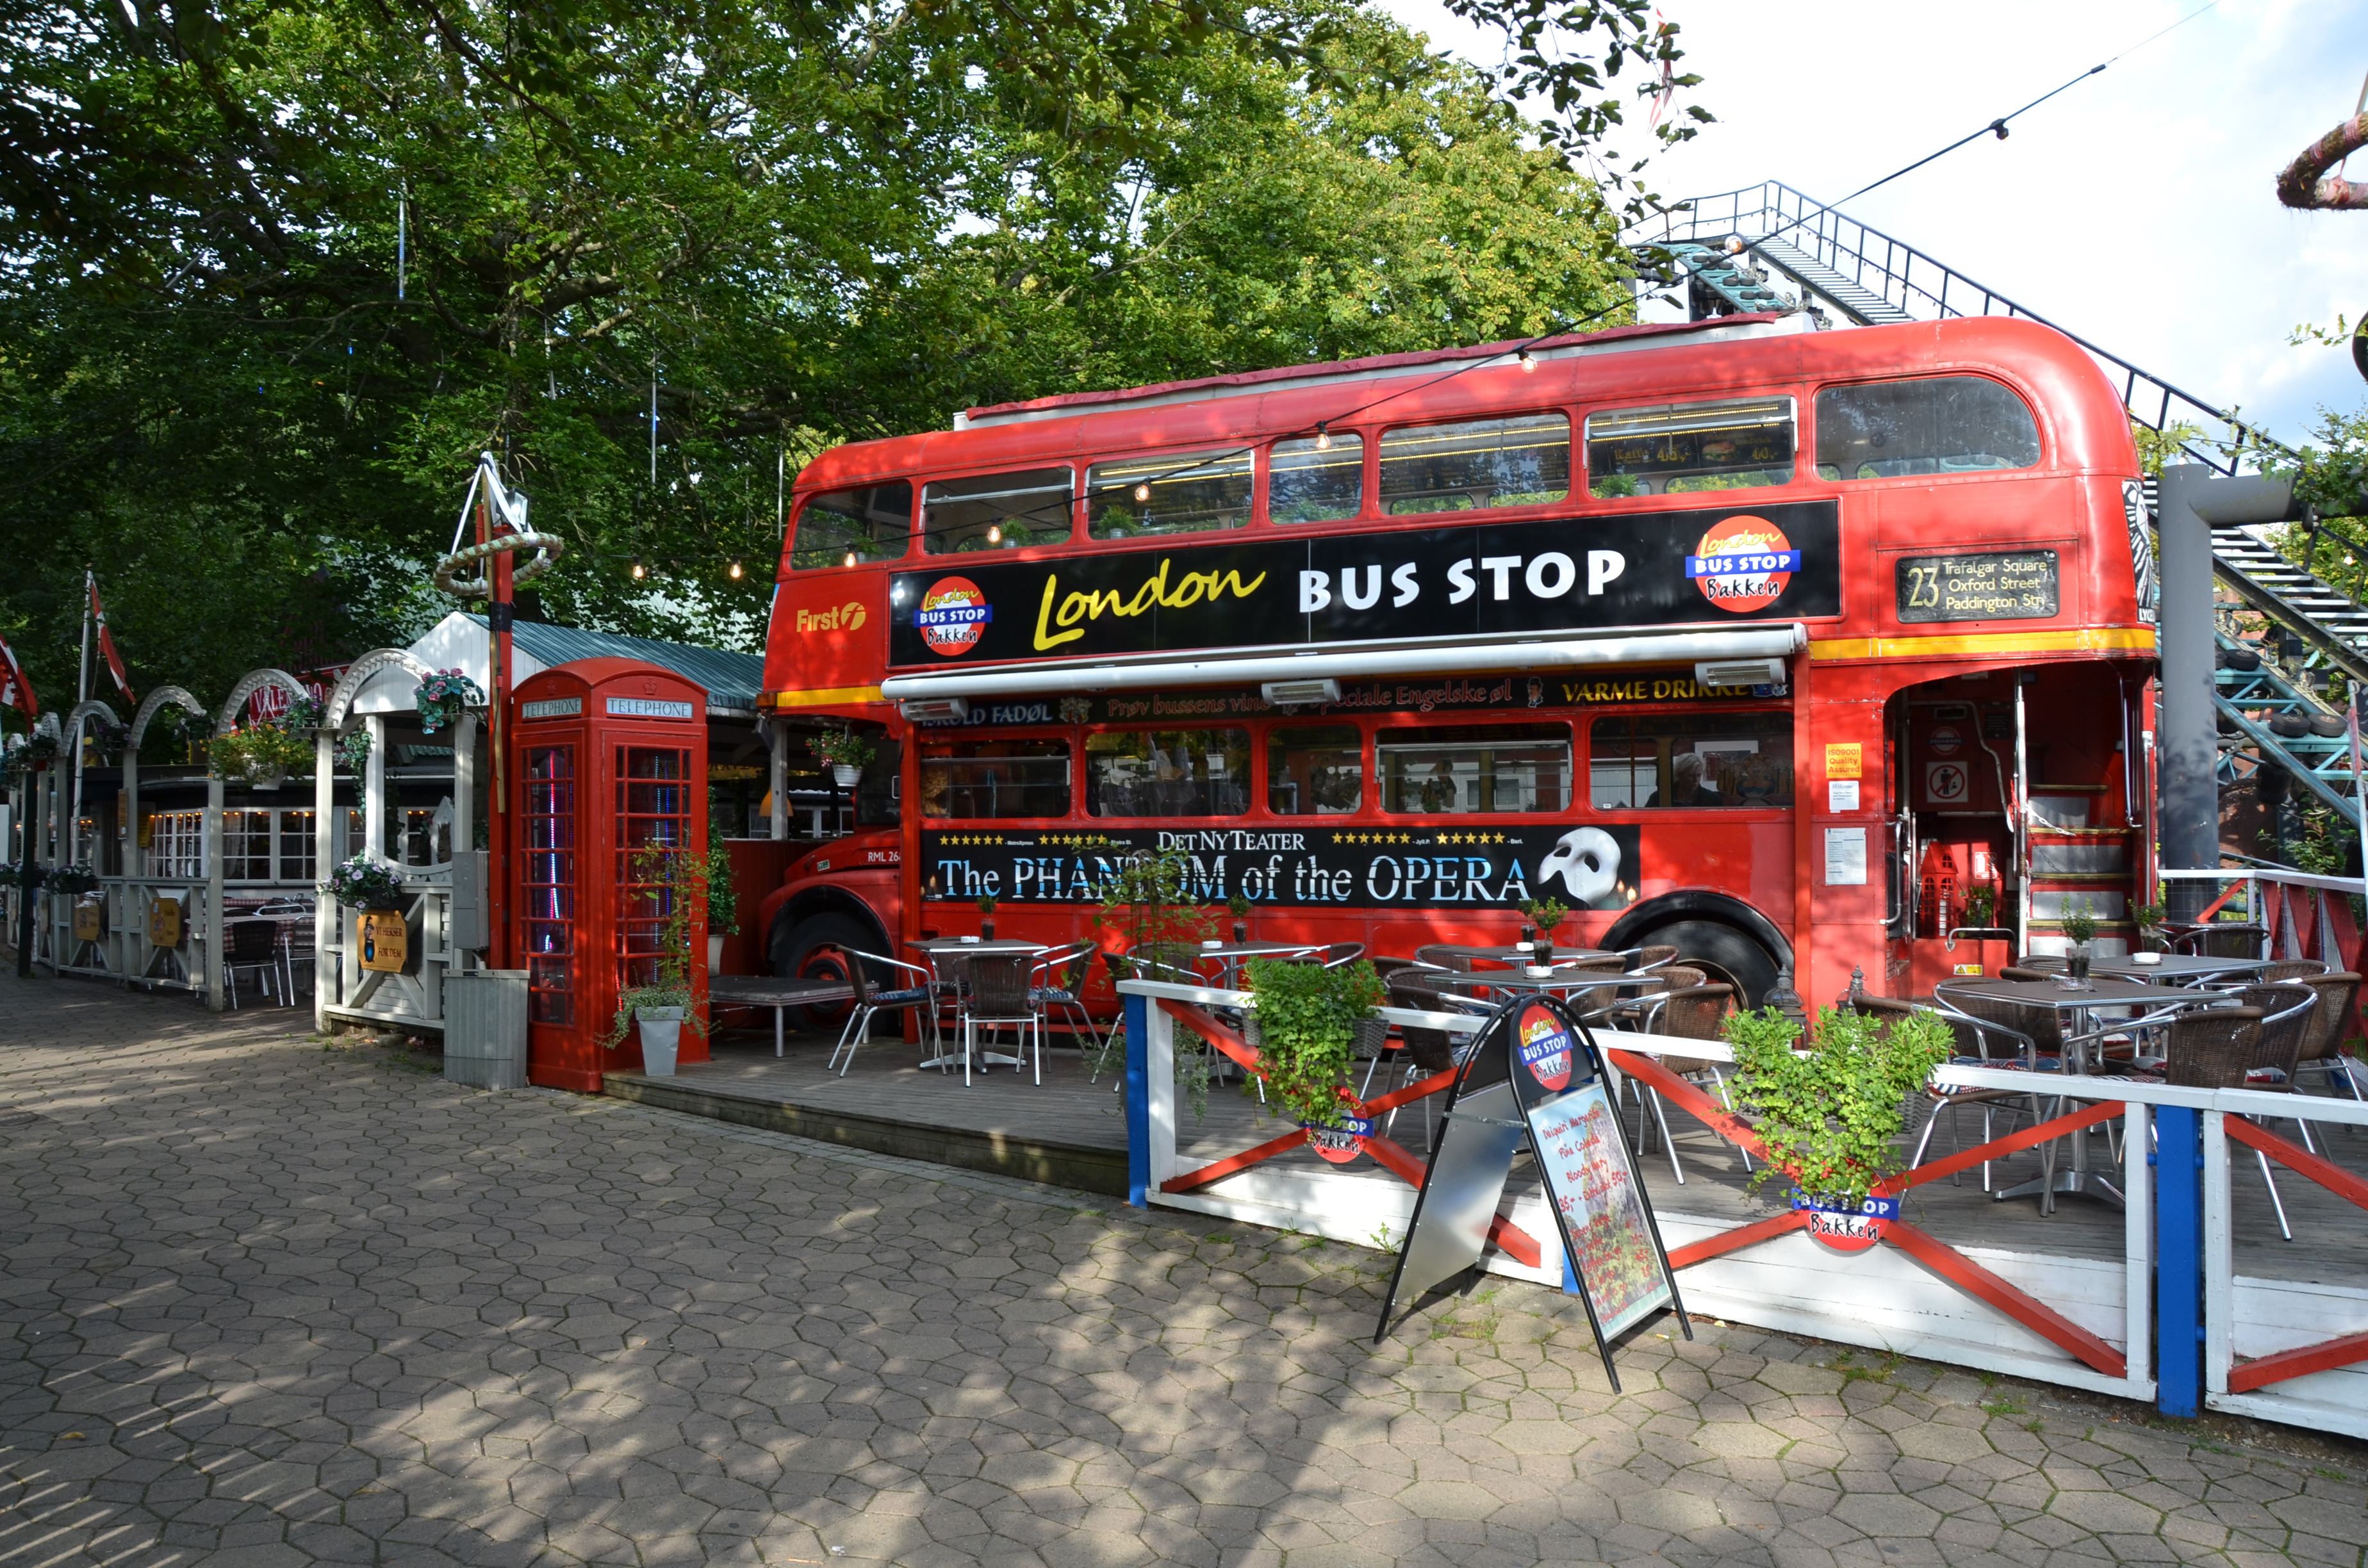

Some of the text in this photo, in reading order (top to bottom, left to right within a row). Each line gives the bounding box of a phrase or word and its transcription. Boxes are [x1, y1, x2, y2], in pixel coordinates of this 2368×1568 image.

[1699, 529, 1781, 559] London
[1695, 555, 1791, 573] BUS STOP
[1943, 559, 2048, 577] Trafalgar Square
[1706, 577, 1780, 600] Bakken
[1908, 567, 1939, 608] 23
[1949, 576, 2041, 592] Oxford Street
[923, 587, 980, 612] London
[1033, 549, 1625, 651] London BUS STOP
[1946, 593, 2046, 612] Paddington Stn
[796, 607, 839, 633] First
[919, 608, 986, 624] BUS STOP
[927, 628, 978, 646] Bakken
[1395, 680, 1486, 712] Engelske
[1489, 678, 1512, 703] øl
[1561, 680, 1648, 702] VARME
[525, 699, 580, 718] TELEPHONE
[609, 698, 688, 717] TELEPHONE
[992, 703, 1054, 724] FADØL
[1107, 695, 1150, 719] Prøv
[1153, 694, 1226, 714] bussens
[1158, 830, 1306, 851] DET NY TEATER
[867, 852, 887, 862] RML
[938, 859, 1001, 897] The
[1241, 854, 1283, 900] of
[1295, 855, 1352, 901] the
[1367, 855, 1531, 901] OPERA
[1520, 1017, 1556, 1048] London
[1523, 1035, 1566, 1061] BUS STOP
[1534, 1059, 1571, 1084] Bakken
[1575, 1131, 1601, 1152] Colada
[1566, 1158, 1609, 1184] Bloody Mary
[1842, 1197, 1889, 1215] SOP
[1810, 1213, 1879, 1241] Bakken
